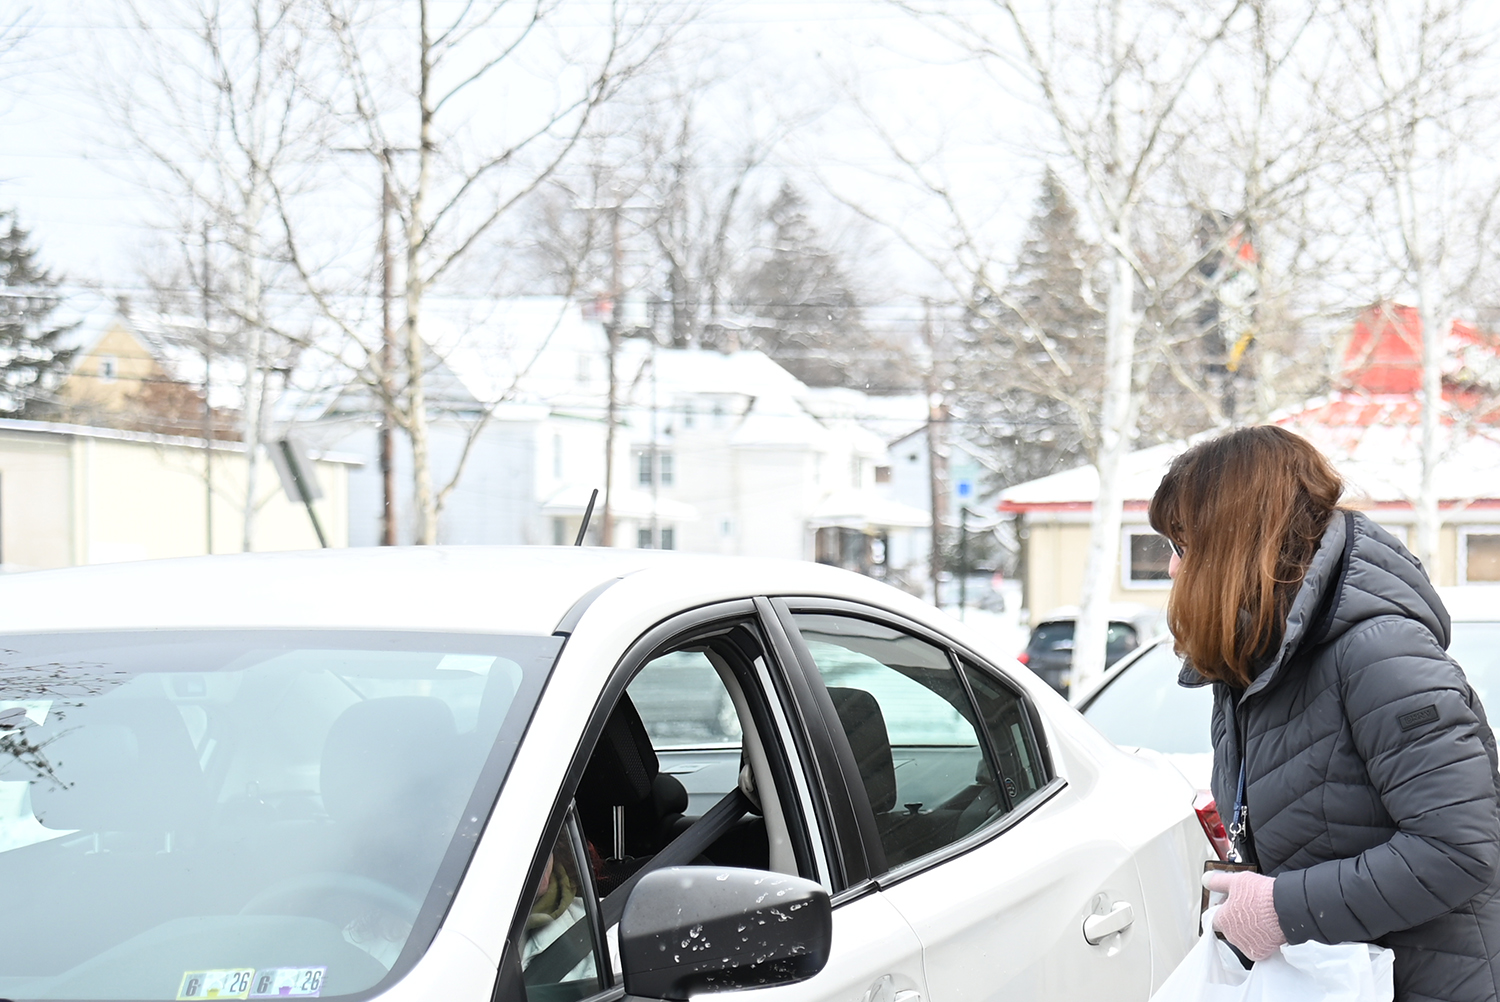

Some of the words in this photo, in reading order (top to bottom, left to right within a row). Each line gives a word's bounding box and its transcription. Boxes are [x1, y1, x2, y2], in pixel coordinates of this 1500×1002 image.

[186, 978, 199, 997] 6
[230, 971, 250, 993] 26
[256, 975, 271, 994] 6
[302, 970, 322, 991] 26
